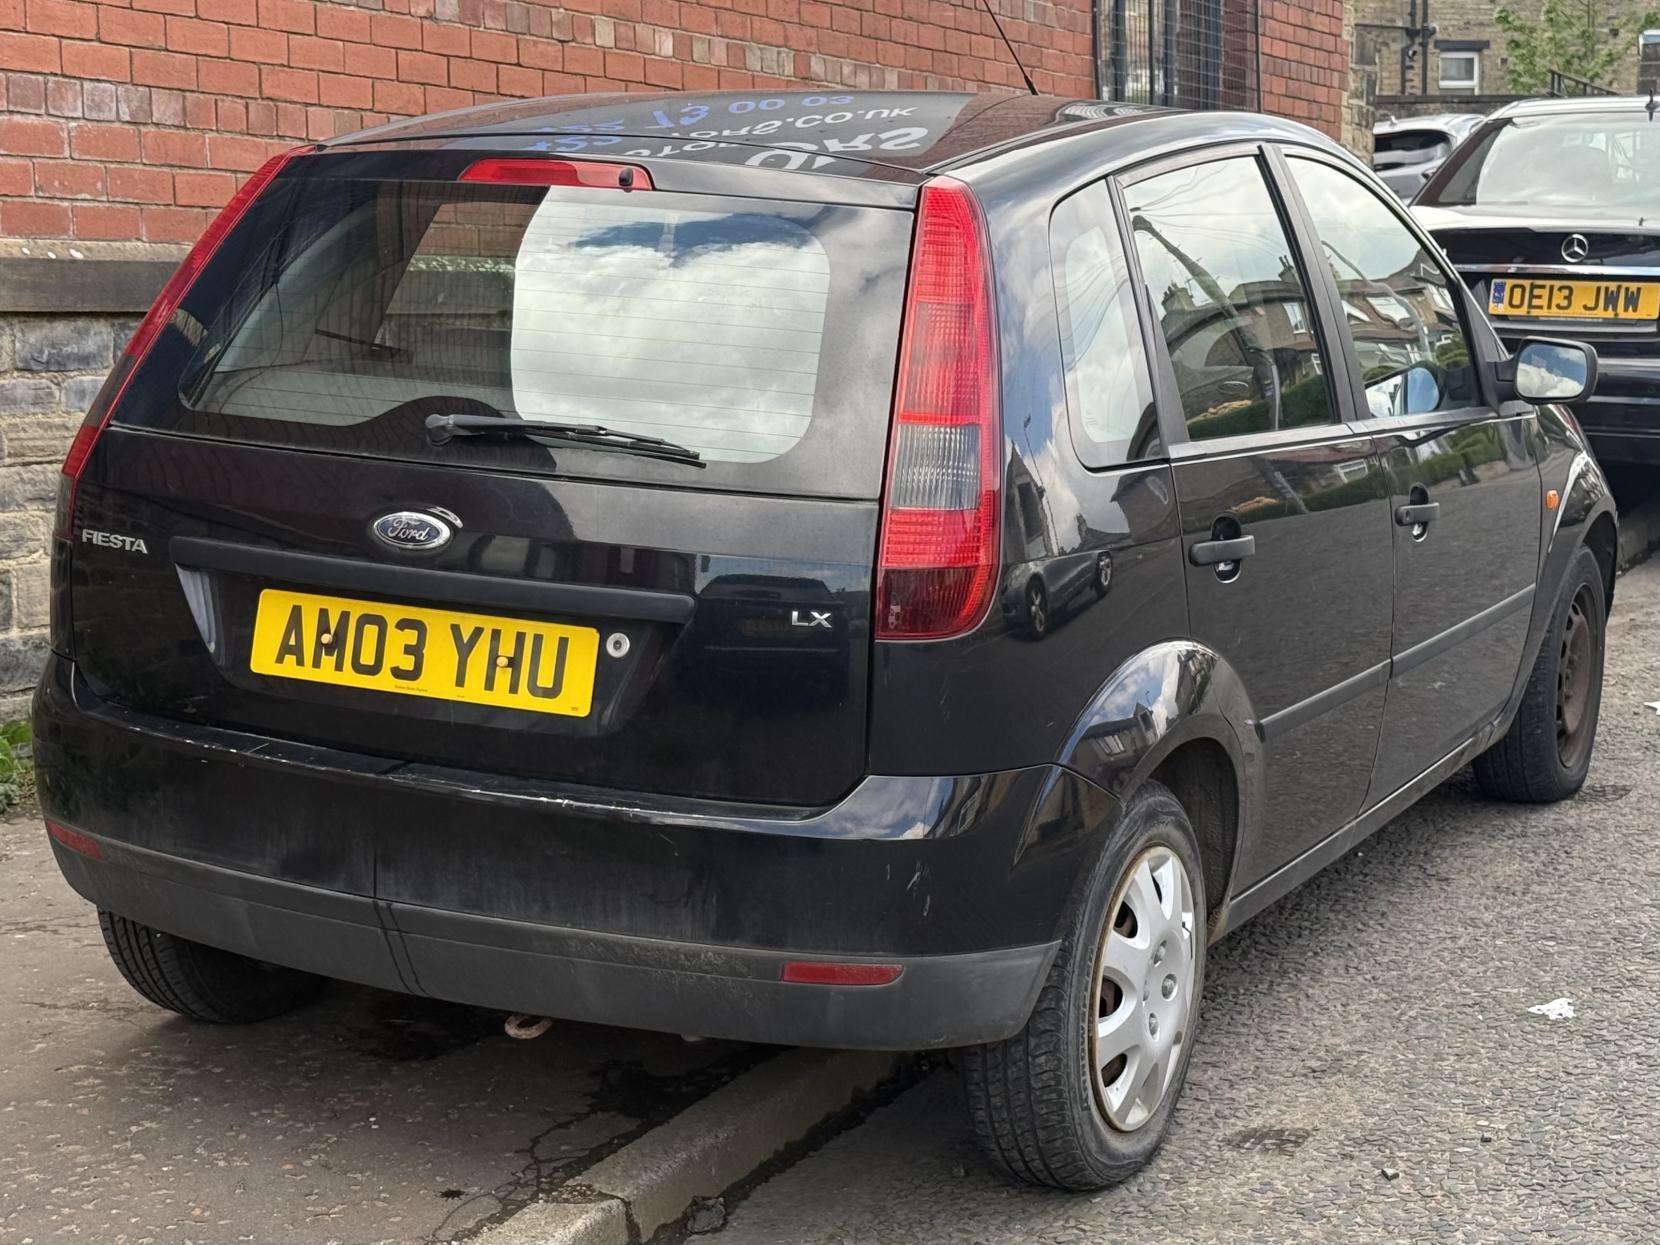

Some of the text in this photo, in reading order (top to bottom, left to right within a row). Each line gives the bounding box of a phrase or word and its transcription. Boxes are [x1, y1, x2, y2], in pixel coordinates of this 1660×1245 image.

[1508, 282, 1642, 314] OE13 JWW
[82, 528, 148, 554] FIESTA
[792, 611, 832, 628] LX
[274, 604, 570, 700] AM03 YHU
